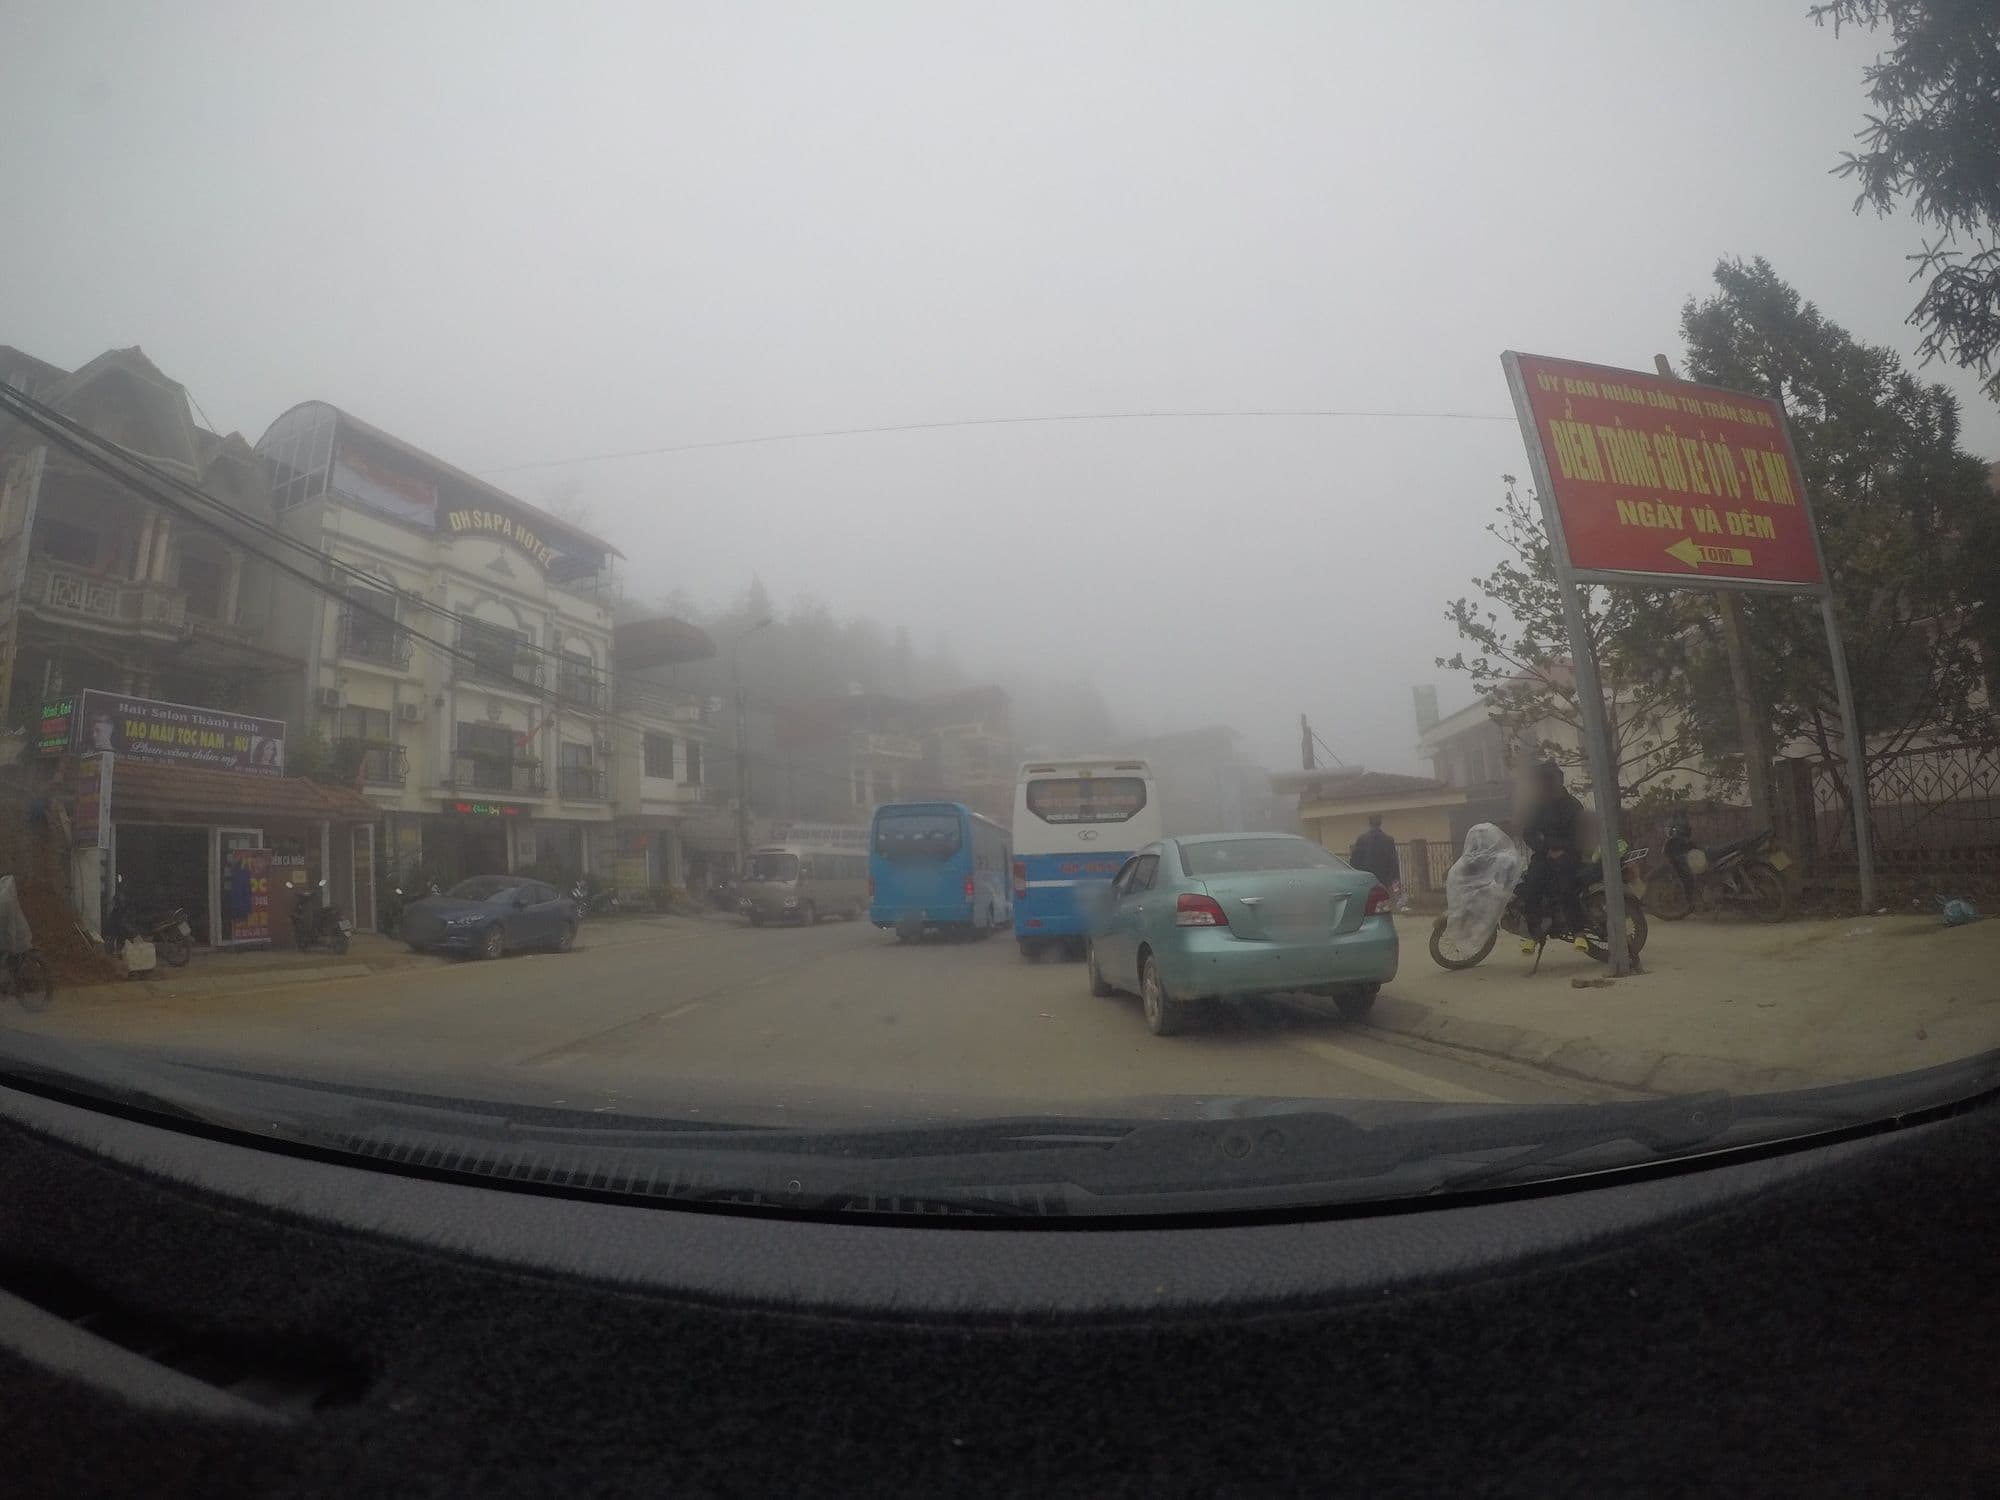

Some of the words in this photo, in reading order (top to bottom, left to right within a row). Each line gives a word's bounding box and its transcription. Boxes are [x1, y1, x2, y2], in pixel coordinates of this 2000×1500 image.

[1563, 377, 1599, 398] BAN
[1739, 408, 1759, 424] SA
[1757, 411, 1774, 428] PA
[1616, 497, 1683, 530] NGÀY
[1690, 504, 1723, 534] VÀ
[1725, 507, 1777, 539] ĐÊM
[473, 510, 511, 535] SAPA
[515, 524, 552, 569] HOTEL
[1701, 547, 1733, 561] 10M
[119, 703, 146, 715] Hair
[151, 709, 188, 722] Salon
[200, 730, 224, 749] NAM
